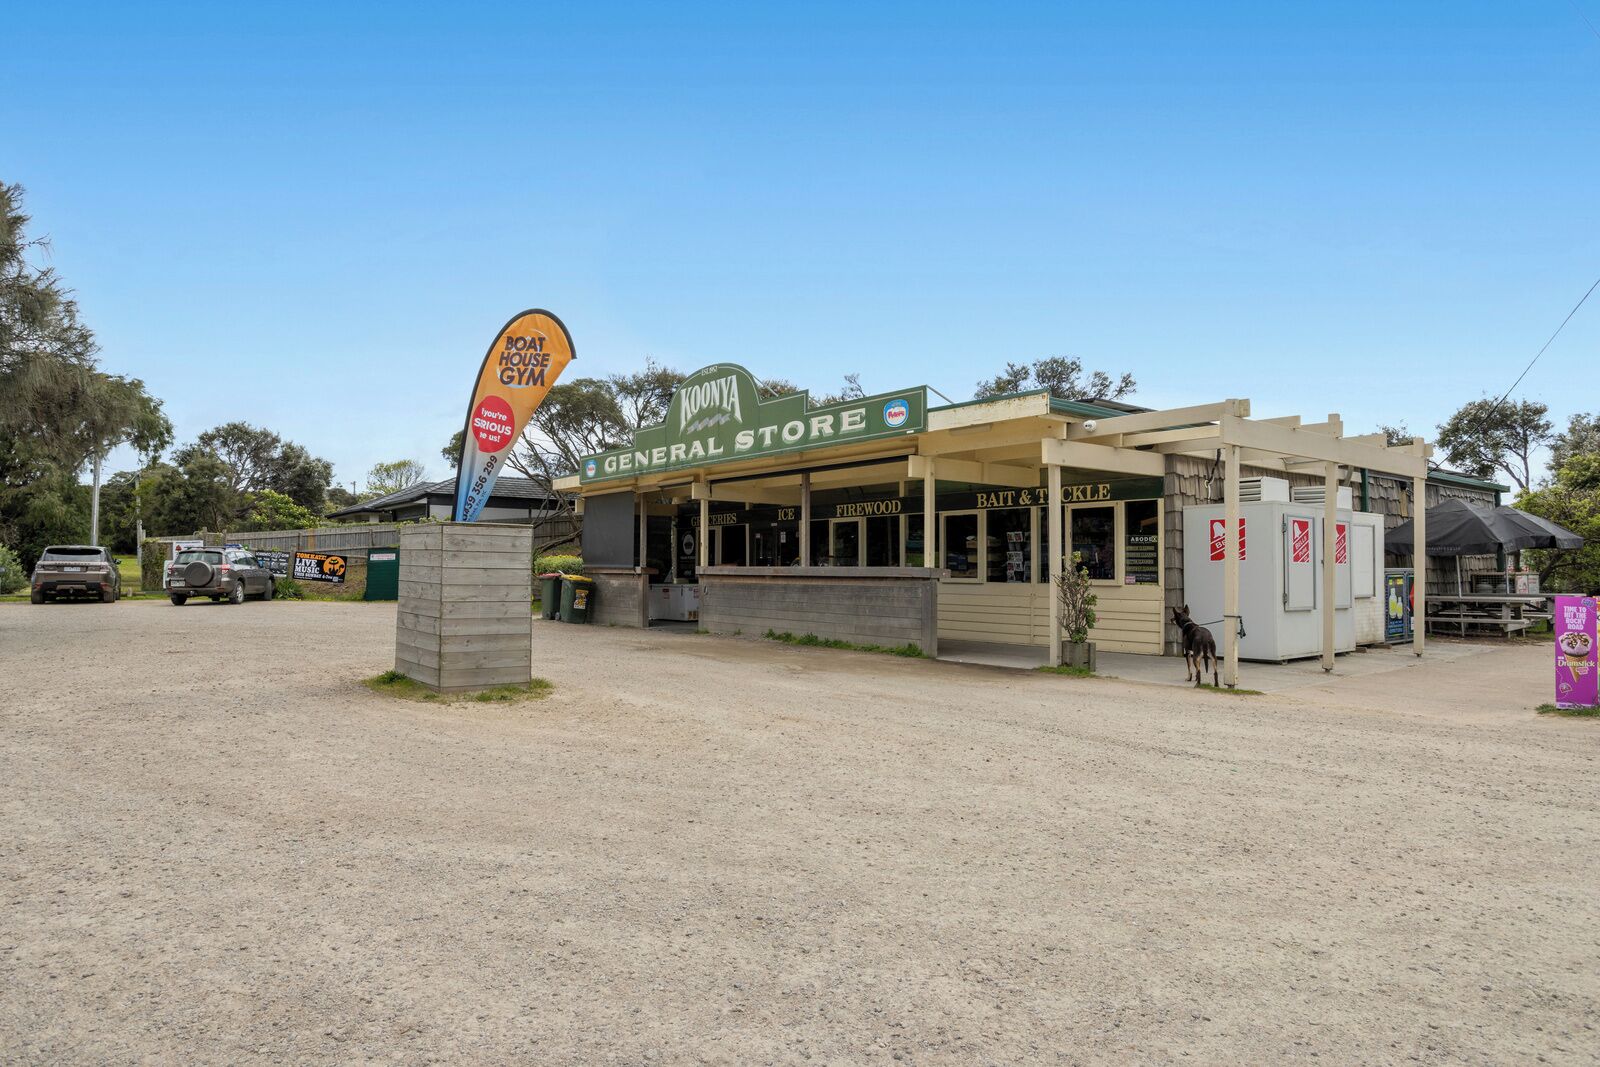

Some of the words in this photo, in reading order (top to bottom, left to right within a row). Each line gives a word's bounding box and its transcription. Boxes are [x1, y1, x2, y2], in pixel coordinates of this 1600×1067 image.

[505, 336, 546, 352] BOAT
[499, 351, 551, 367] HOUSE
[500, 366, 545, 387] GYM
[679, 374, 742, 437] KOONYA
[604, 437, 724, 474] GENERAL
[735, 407, 866, 453] STORE
[472, 475, 488, 496] 356
[483, 455, 498, 476] 299
[976, 490, 1015, 508] BAIT
[1019, 489, 1032, 505] &
[1035, 483, 1111, 504] TCKLE
[777, 508, 795, 521] ICE
[836, 500, 902, 517] FIREWOOD
[691, 512, 737, 527] GCERIES
[294, 565, 320, 574] MUSIC
[296, 557, 318, 567] LIVE
[1565, 617, 1586, 625] ROCKY
[1557, 659, 1595, 667] Drumstick
